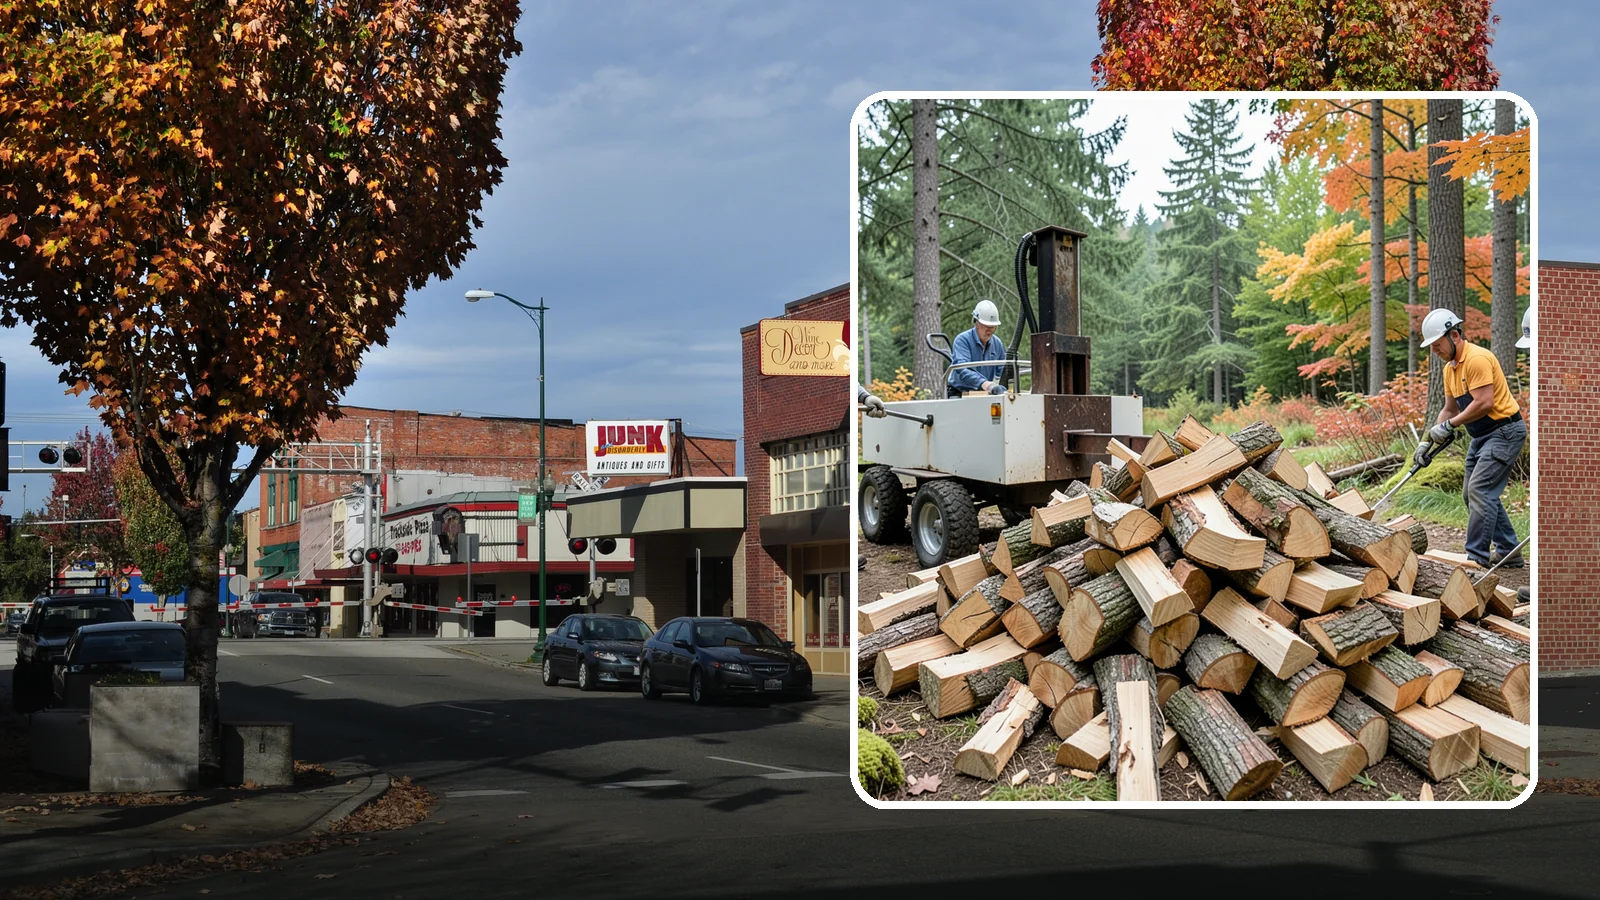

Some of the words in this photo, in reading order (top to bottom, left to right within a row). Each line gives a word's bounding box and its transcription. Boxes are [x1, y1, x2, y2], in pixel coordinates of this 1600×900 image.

[595, 424, 665, 457] JUNK
[607, 446, 646, 454] DISORDERLY
[597, 461, 628, 470] ANTIQUES
[631, 461, 644, 470] AND
[647, 460, 666, 470] GIFTS
[390, 521, 413, 540] Trackside
[414, 519, 430, 535] Pizza
